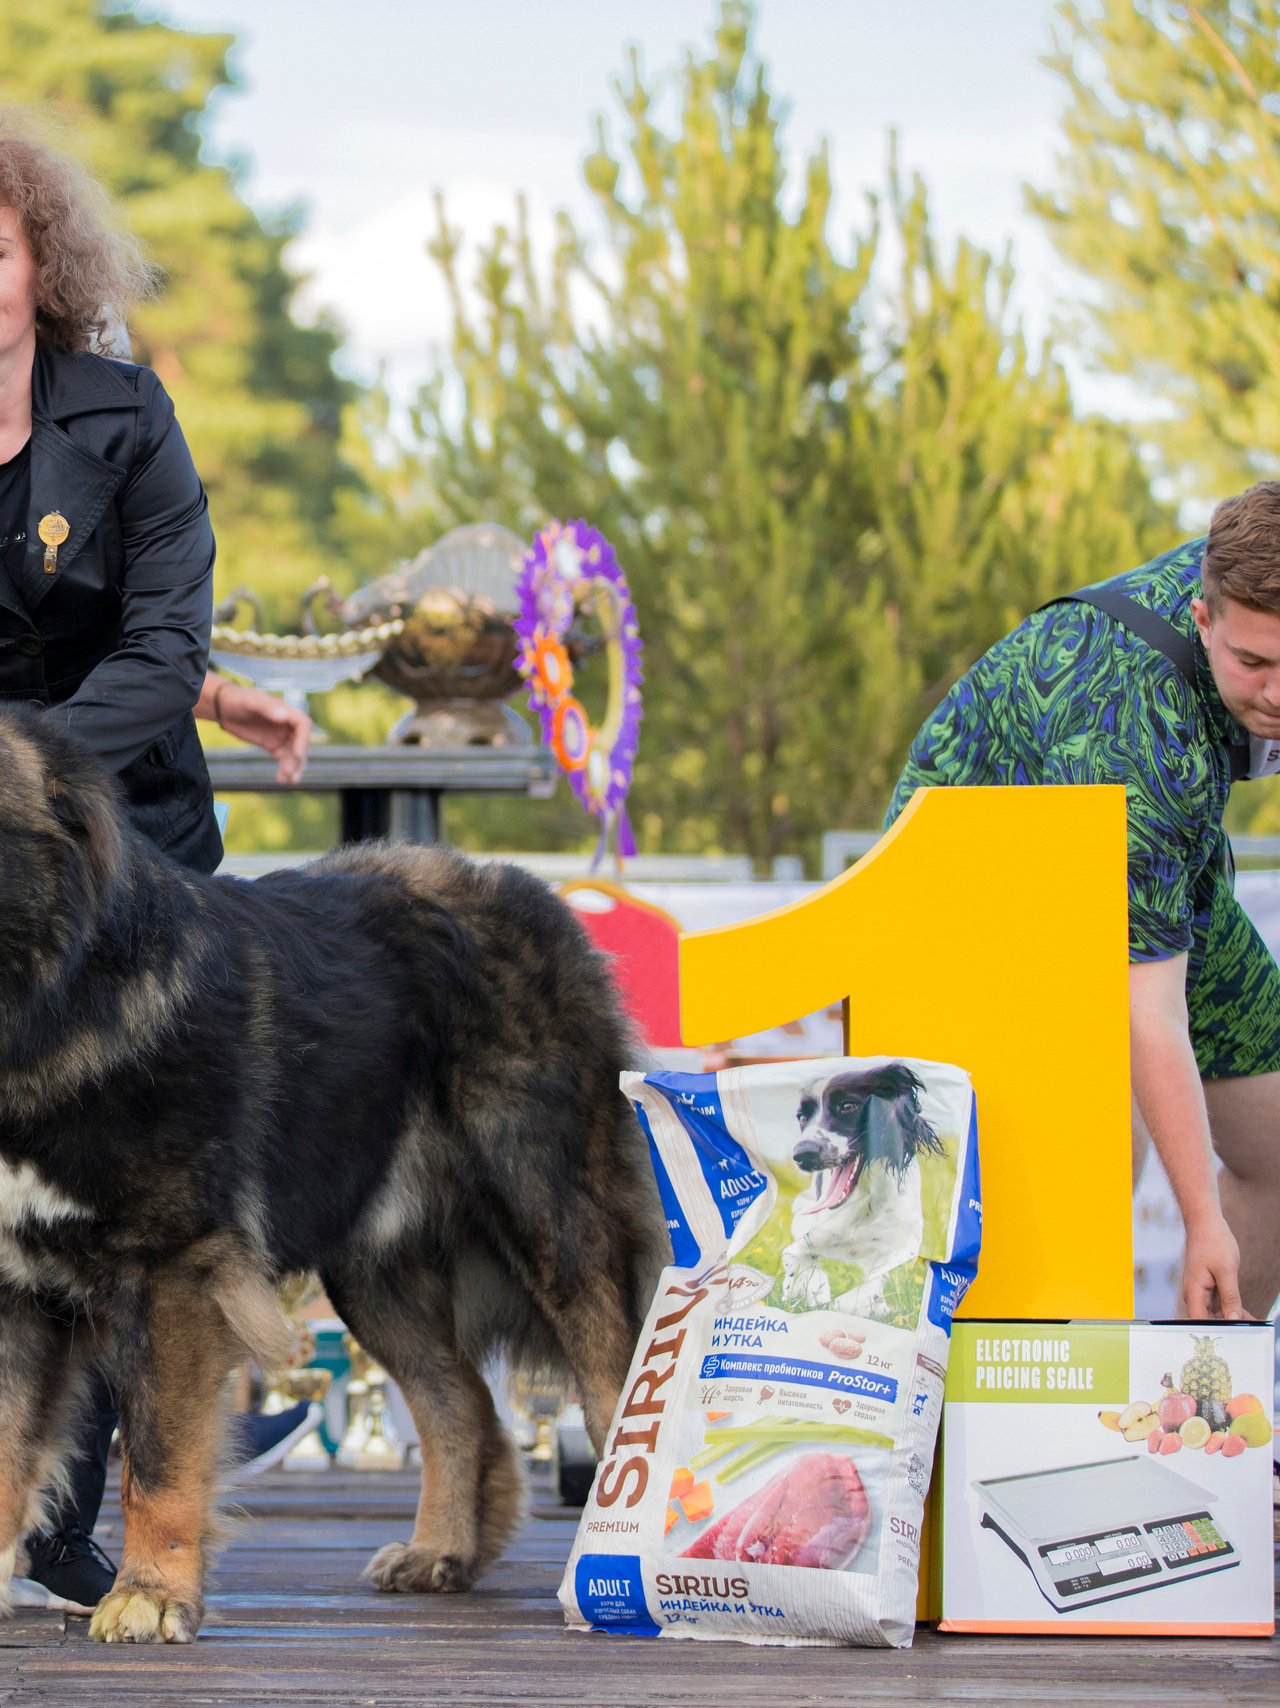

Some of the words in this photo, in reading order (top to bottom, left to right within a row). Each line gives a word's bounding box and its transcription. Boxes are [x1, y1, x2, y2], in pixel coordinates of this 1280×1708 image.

[721, 1170, 763, 1199] ADULT
[714, 1316, 789, 1333] ИНДЕЙКА
[711, 1335, 720, 1347] И
[723, 1334, 763, 1348] УТКА
[976, 1339, 1070, 1363] ELECTRONIC
[720, 1359, 762, 1372] Комплекс
[764, 1364, 824, 1380] пробиотиков
[866, 1355, 880, 1366] 12
[880, 1361, 894, 1370] кг
[827, 1370, 891, 1394] ProStor+
[975, 1366, 1041, 1389] PRICING
[1046, 1367, 1093, 1390] SCALE
[724, 1384, 753, 1394] Здоровая
[779, 1389, 807, 1399] Высокая
[777, 1399, 824, 1411] питательность
[855, 1401, 886, 1415] Здоровое
[853, 1410, 877, 1422] сердце
[587, 1521, 639, 1533] PREMIUM
[1116, 1536, 1138, 1548] 0.00
[1065, 1547, 1092, 1560] 0.000
[1127, 1555, 1149, 1567] 0.00
[588, 1579, 630, 1597] ADULT
[655, 1574, 748, 1598] SIRIUS
[660, 1599, 730, 1613] ИНДЕЙКА
[735, 1603, 745, 1613] И
[749, 1602, 785, 1618] УТКА
